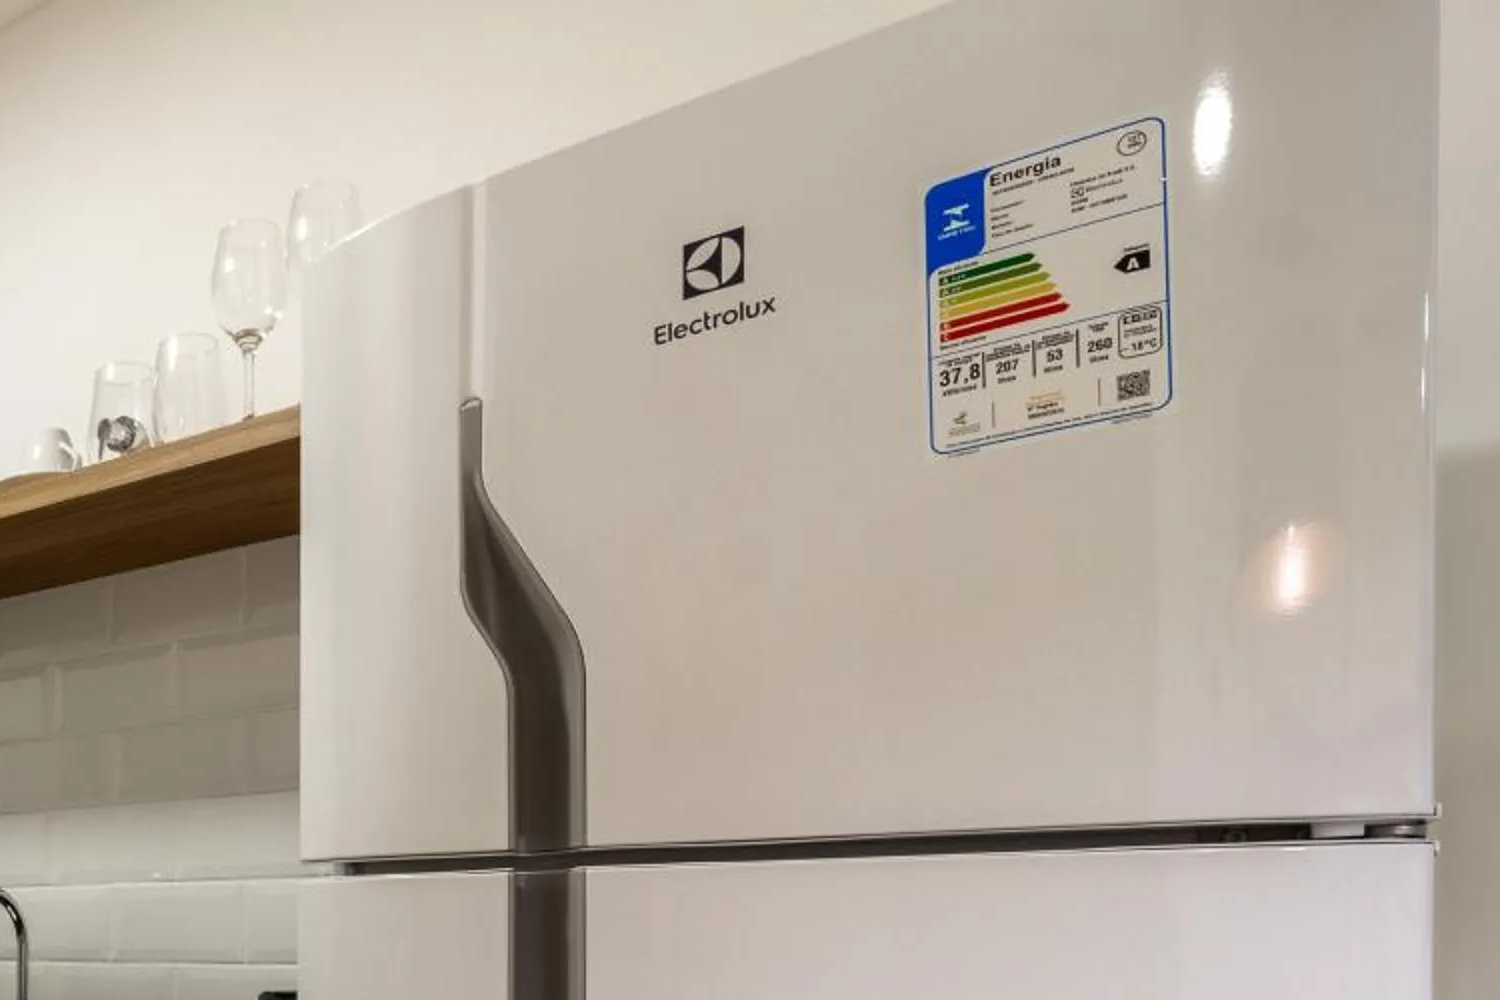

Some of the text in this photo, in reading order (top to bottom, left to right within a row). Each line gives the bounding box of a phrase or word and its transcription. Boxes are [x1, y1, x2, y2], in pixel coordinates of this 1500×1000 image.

[990, 156, 1061, 187] Energia
[1126, 257, 1140, 270] A
[654, 297, 776, 345] Electrolux
[1087, 337, 1112, 352] 260
[1046, 347, 1063, 362] 53
[939, 363, 980, 387] 37,8
[996, 358, 1018, 375] 207
